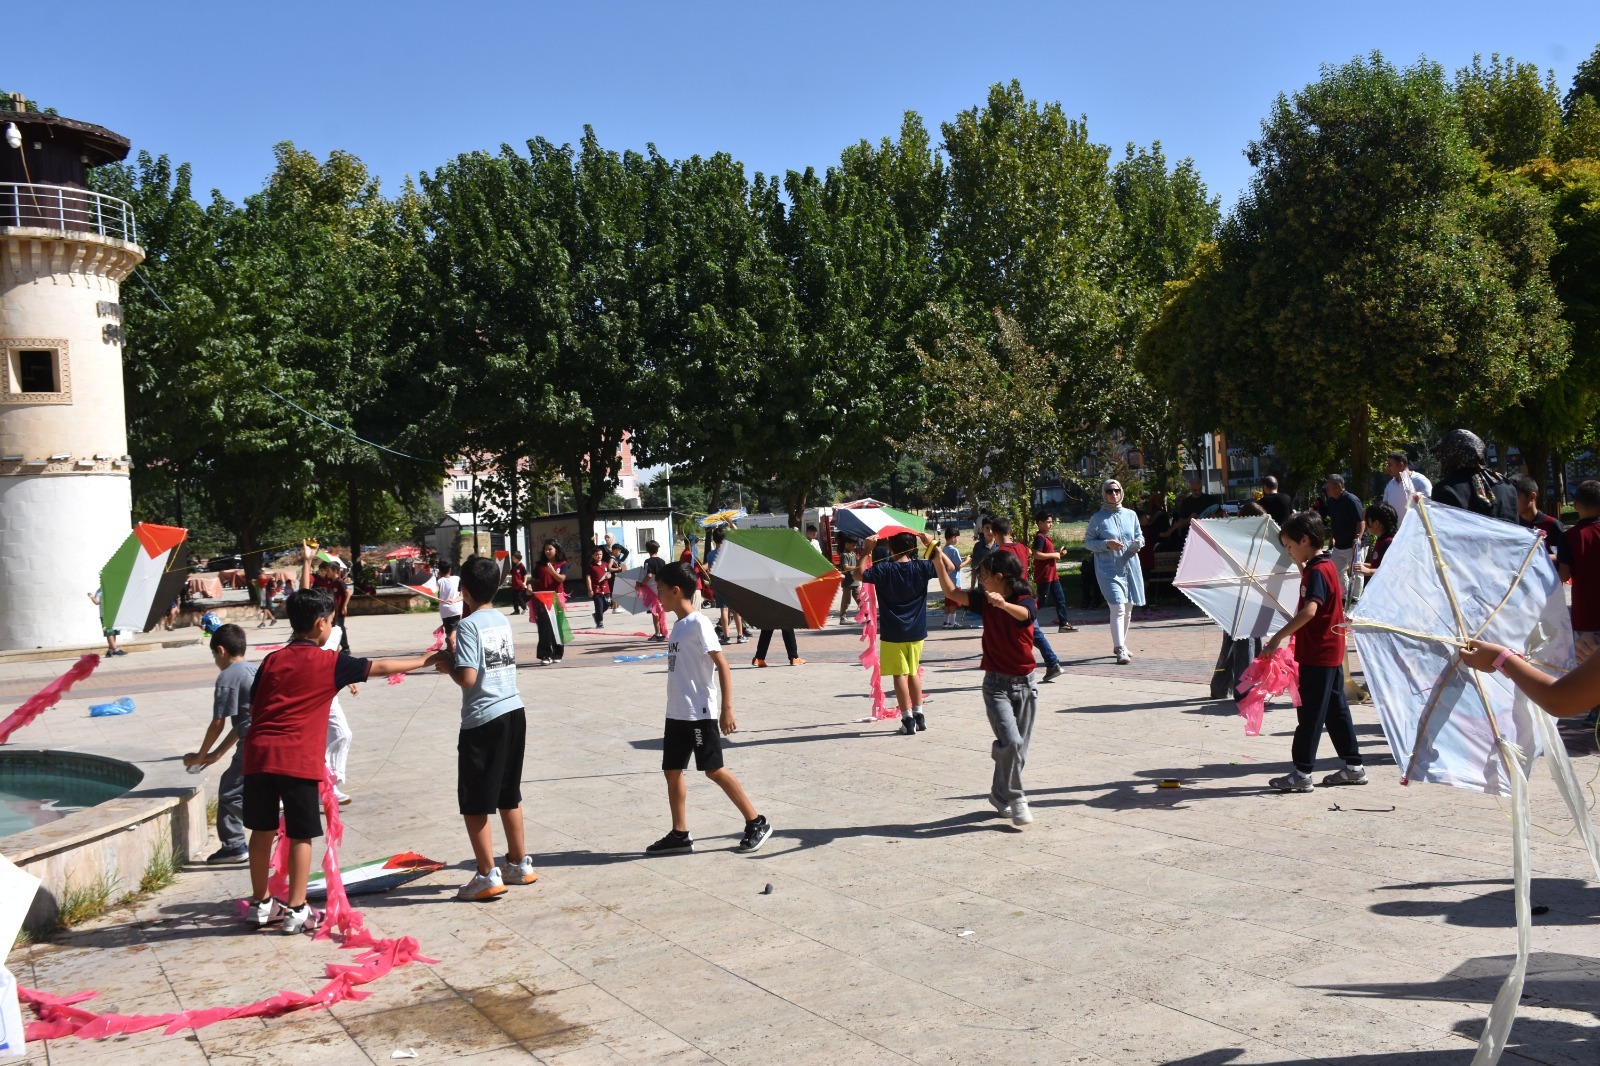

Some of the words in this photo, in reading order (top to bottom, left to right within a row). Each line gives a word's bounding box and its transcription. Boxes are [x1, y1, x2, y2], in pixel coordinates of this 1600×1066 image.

[209, 616, 220, 625] 10
[668, 642, 680, 652] UN.
[694, 728, 703, 747] RUN.
